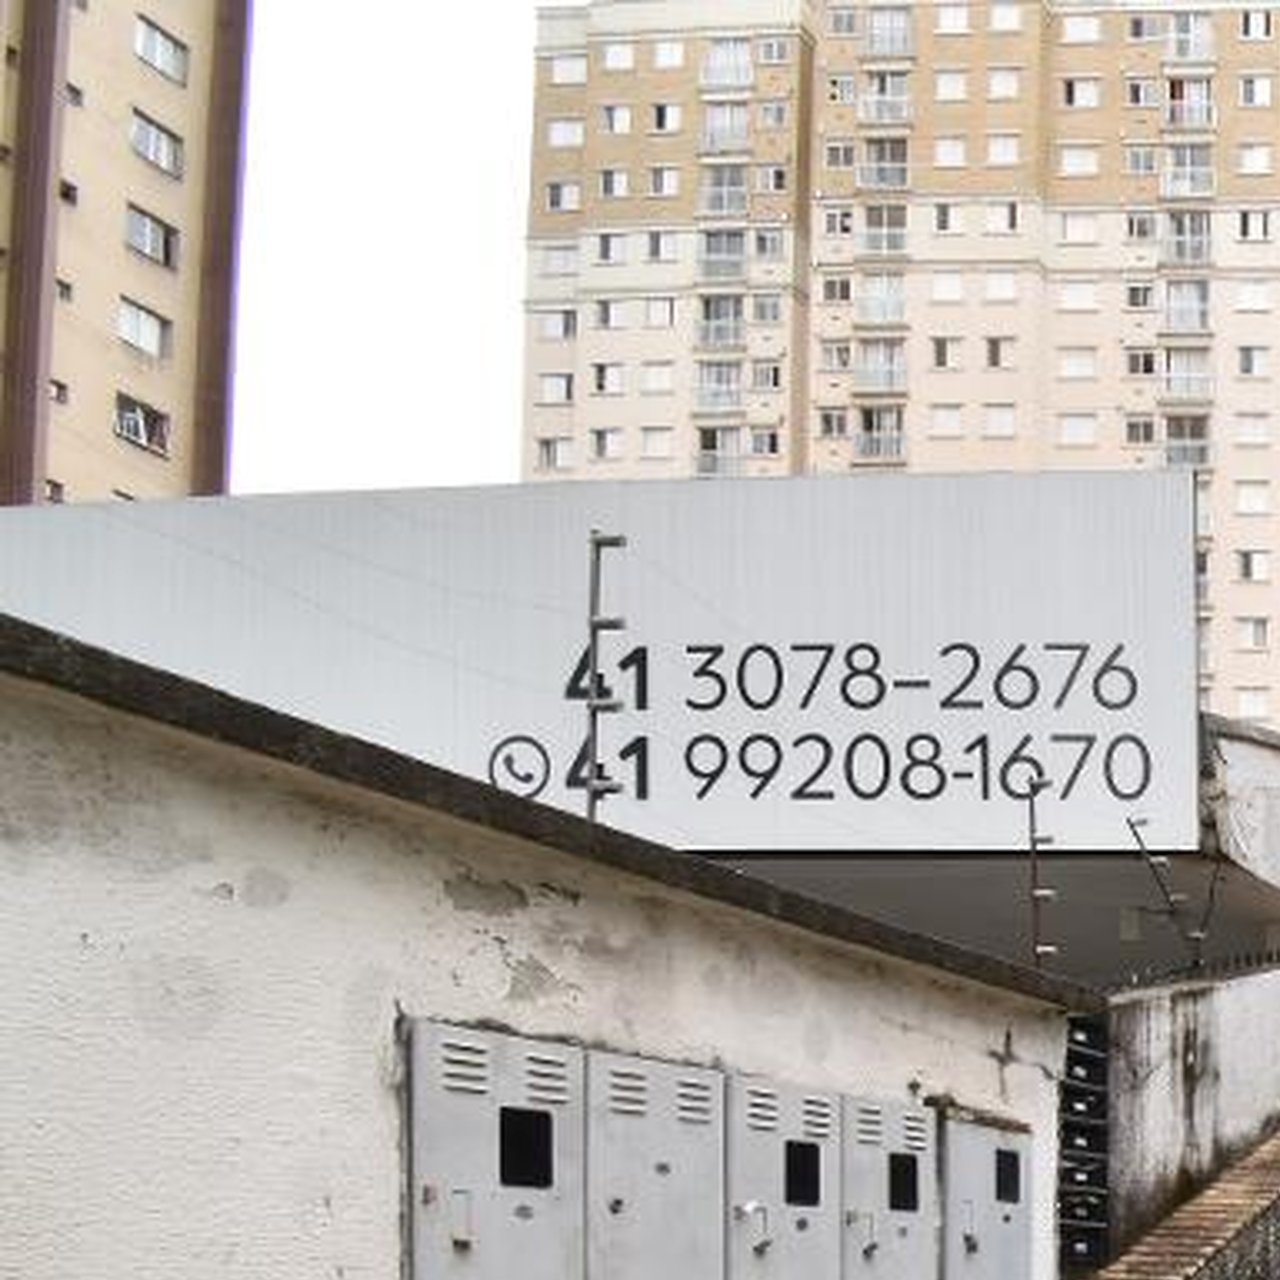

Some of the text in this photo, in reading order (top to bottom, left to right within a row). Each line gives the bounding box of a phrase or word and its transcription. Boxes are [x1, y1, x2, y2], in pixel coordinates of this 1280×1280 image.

[565, 643, 1138, 710] 41 3078-2676
[565, 733, 1152, 800] 41 99208-1670
